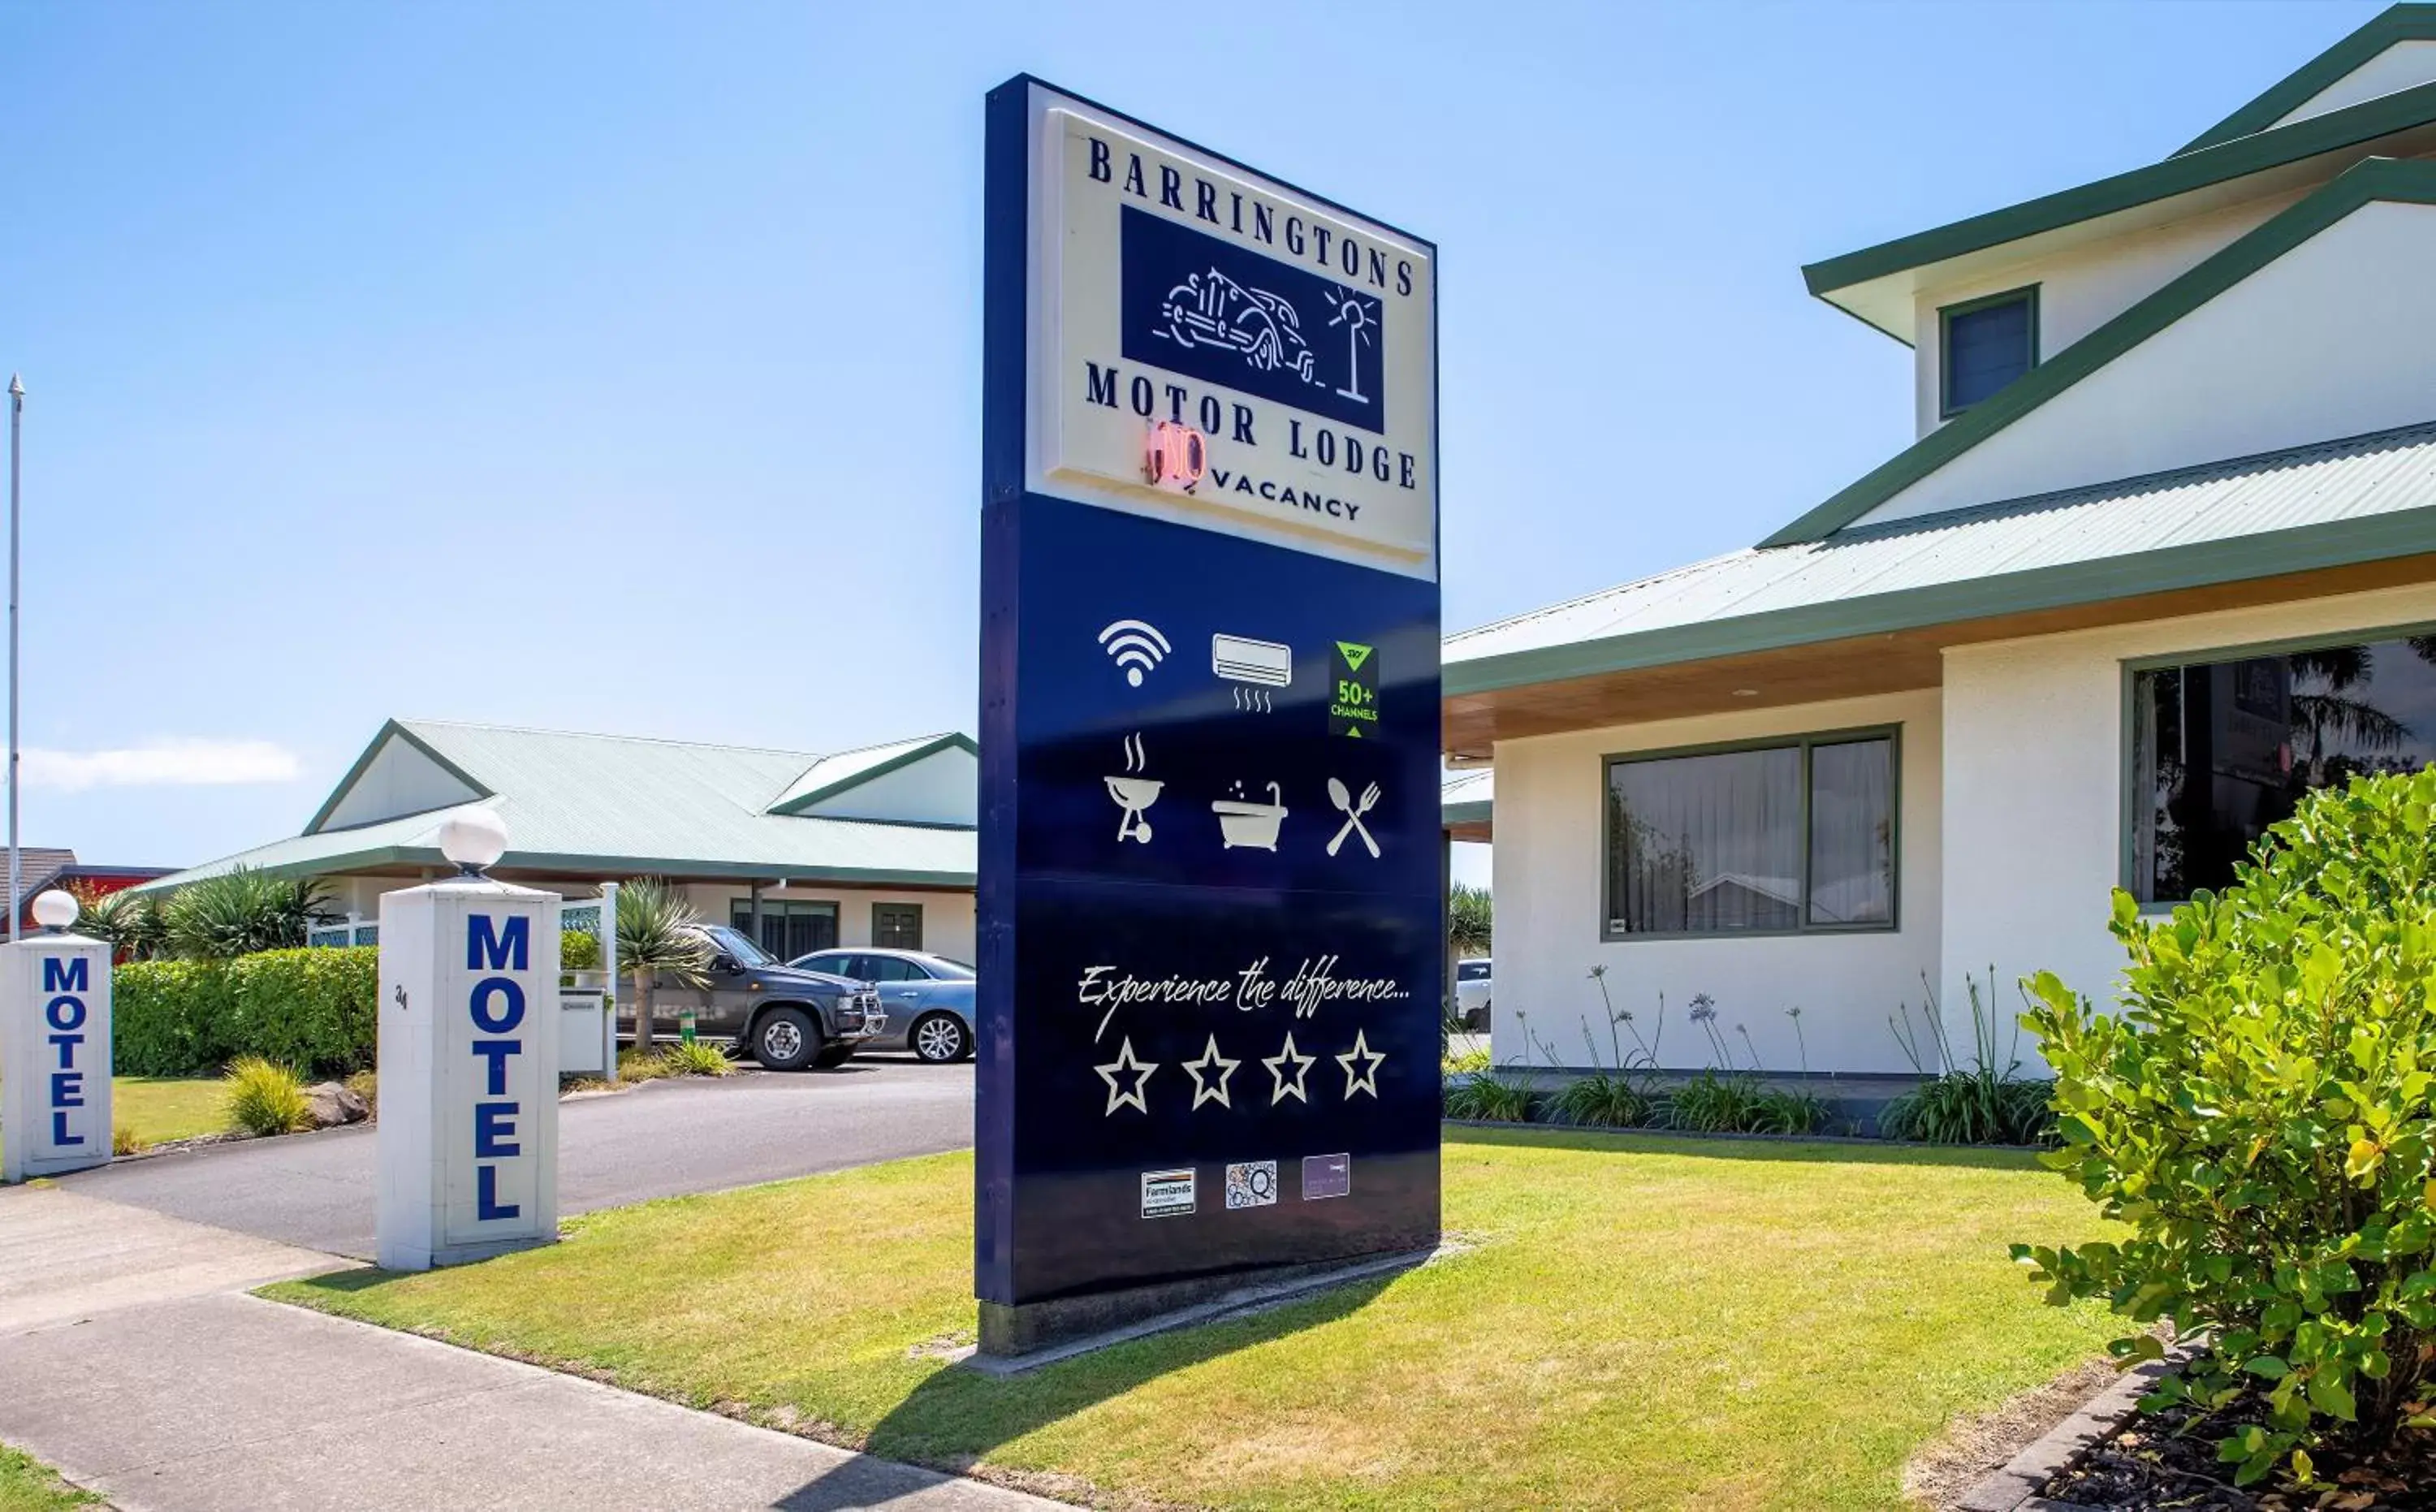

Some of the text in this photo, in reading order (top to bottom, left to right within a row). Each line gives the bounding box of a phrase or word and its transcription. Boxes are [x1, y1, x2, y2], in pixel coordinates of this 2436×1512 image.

[1088, 137, 1413, 297] BARRINGTONS
[1086, 361, 1416, 490] MOTOR LODGE
[1211, 469, 1360, 521] VACANCY
[1331, 704, 1378, 721] CHANNELS
[1339, 680, 1373, 705] 50+
[43, 957, 89, 1147] MOTEL
[1078, 954, 1410, 1044] Experience the difference...
[467, 914, 530, 1222] MOTEL
